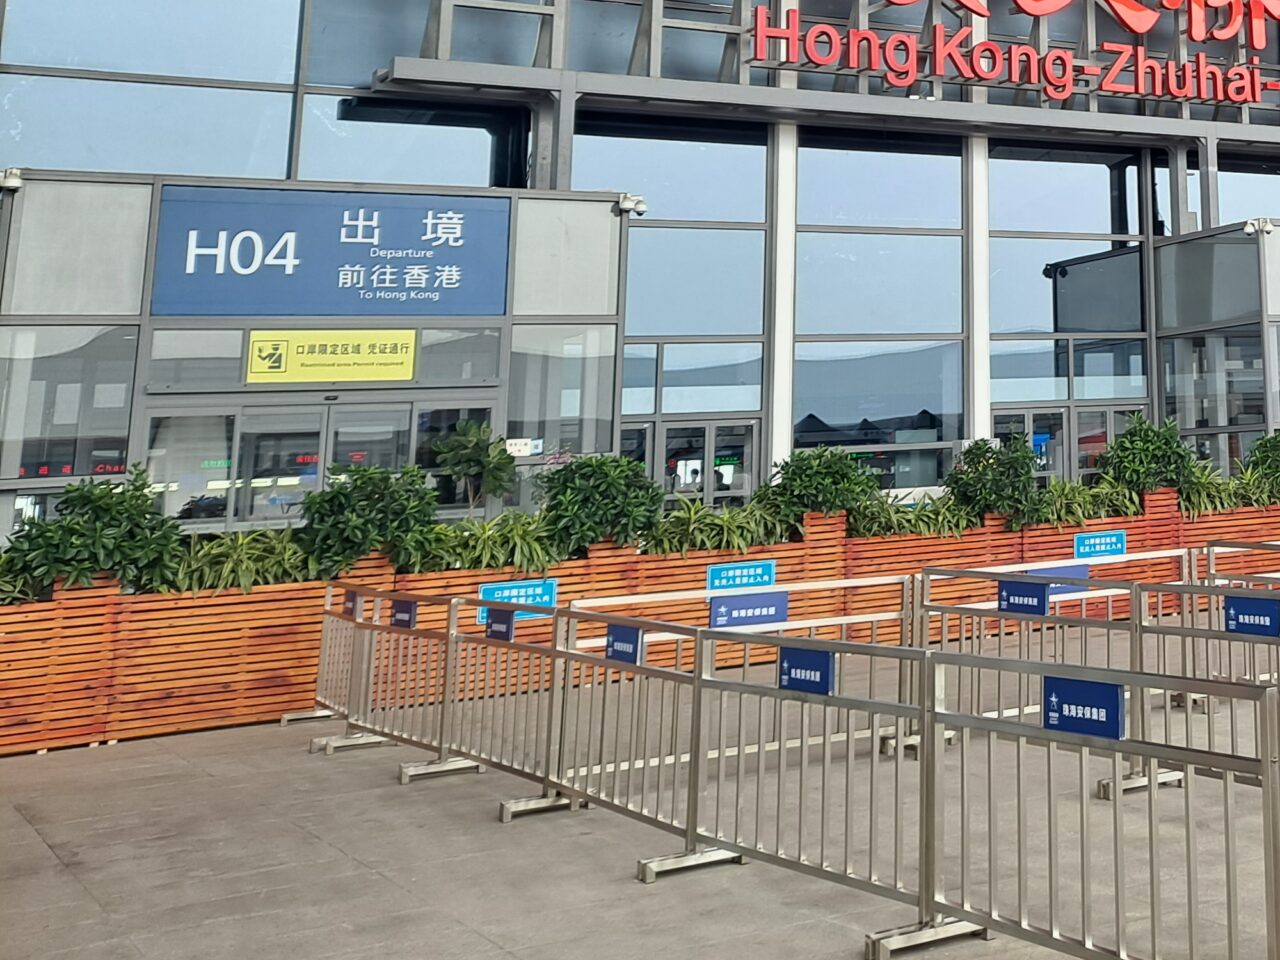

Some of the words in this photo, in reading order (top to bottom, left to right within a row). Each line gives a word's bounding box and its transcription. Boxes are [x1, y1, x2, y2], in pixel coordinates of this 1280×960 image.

[754, 6, 918, 87] Hong
[185, 229, 300, 275] H04
[370, 247, 434, 259] Departure
[338, 264, 462, 288] 前往香港
[359, 290, 373, 300] To
[376, 290, 407, 301] Hong
[410, 291, 440, 302] Kong
[1062, 703, 1107, 722] 珠海安保集团
